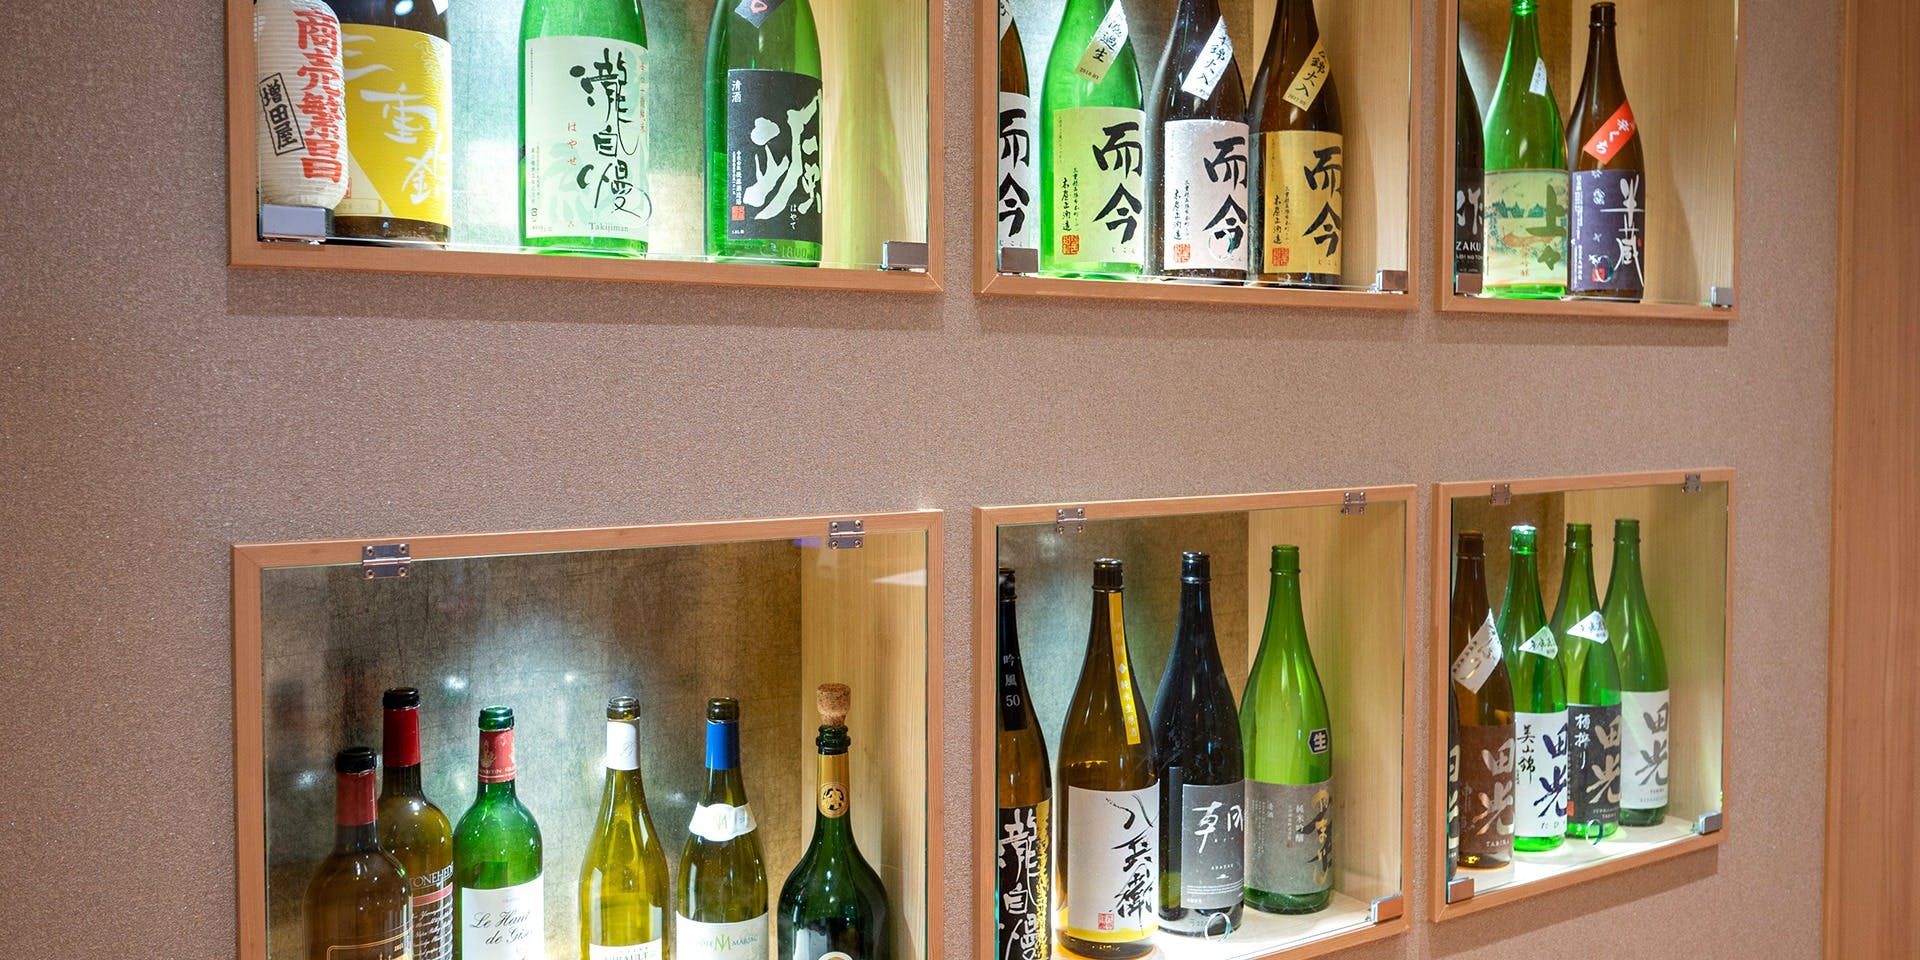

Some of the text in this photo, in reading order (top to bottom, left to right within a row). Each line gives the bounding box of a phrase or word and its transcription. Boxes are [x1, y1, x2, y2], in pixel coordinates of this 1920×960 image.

[731, 80, 742, 103] 清酒
[1000, 108, 1030, 237] 而今
[1092, 121, 1142, 244] 而今
[1202, 136, 1248, 253] 而今
[1302, 146, 1342, 257] 而今
[589, 222, 629, 233] Takijiman
[790, 204, 798, 230] はやて
[1456, 240, 1482, 252] ZAKU
[1600, 174, 1645, 287] 半蔵
[1314, 732, 1327, 751] 生
[1517, 724, 1536, 784] 美山錦
[1533, 722, 1568, 818] 田光
[1586, 714, 1621, 804] 田光
[1635, 701, 1667, 786] 田光
[1473, 738, 1514, 836] 田光
[1106, 793, 1158, 934] 八兵衛
[469, 911, 491, 928] Le
[485, 930, 503, 945] de
